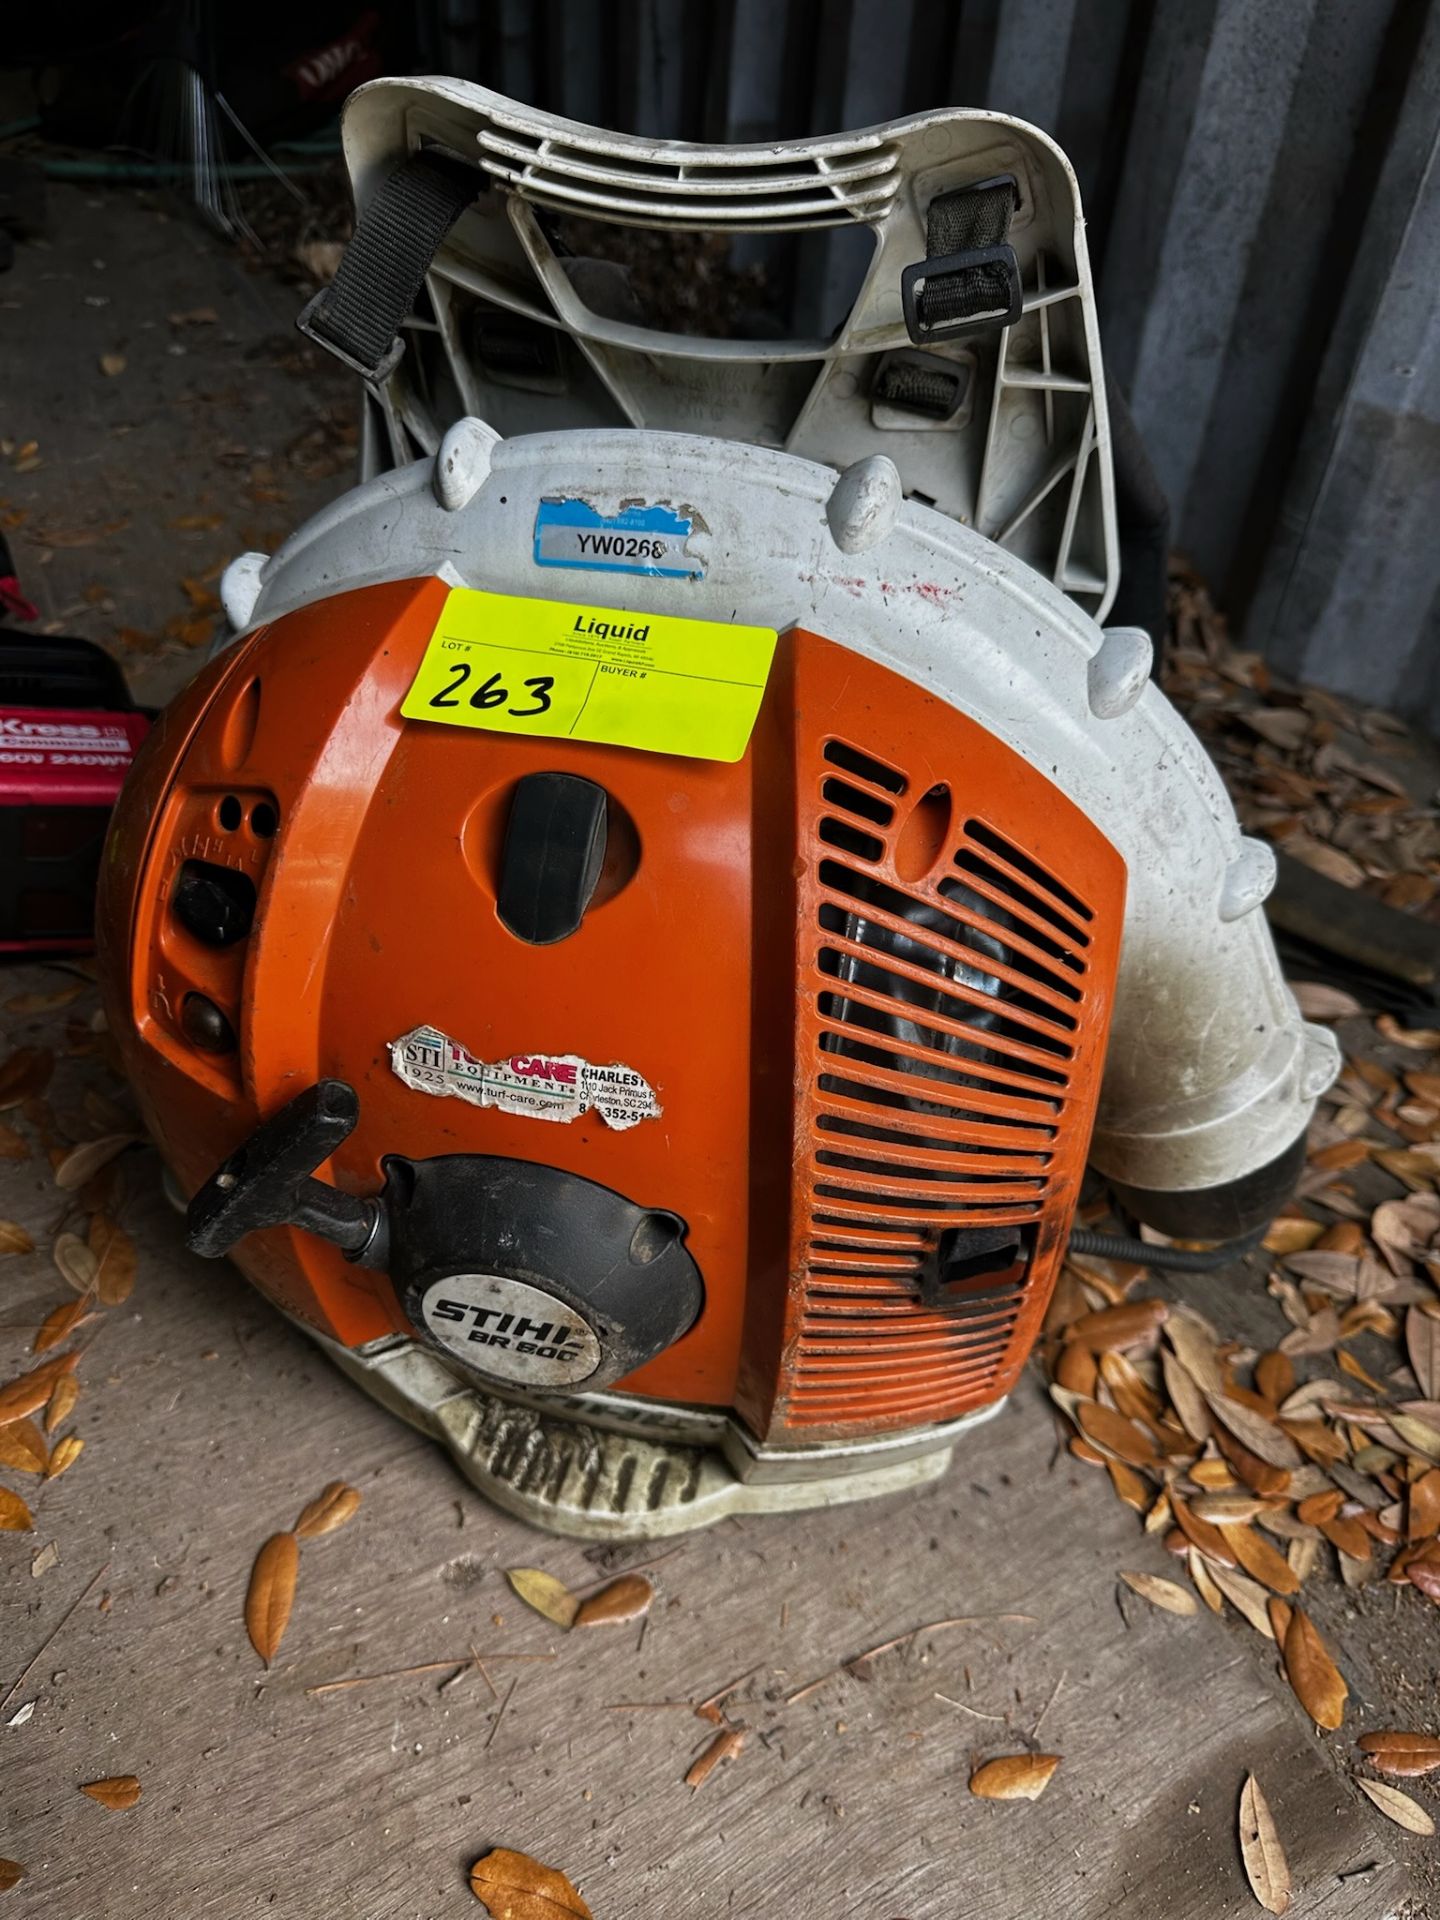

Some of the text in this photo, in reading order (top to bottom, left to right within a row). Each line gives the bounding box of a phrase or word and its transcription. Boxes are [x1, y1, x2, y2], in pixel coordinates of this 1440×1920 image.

[577, 534, 663, 560] YW0268
[573, 615, 650, 642] Liquid
[441, 641, 471, 652] LOT #
[600, 665, 647, 679] BUYER #
[429, 663, 555, 716] 263
[0, 718, 100, 737] Kress
[406, 1043, 441, 1069] STI
[511, 1056, 577, 1084] CARE
[457, 1081, 565, 1110] www.turf-care.com
[599, 1083, 618, 1095] Jack
[624, 1098, 637, 1108] SC
[432, 1299, 585, 1349] STIHL
[468, 1330, 511, 1349] BR
